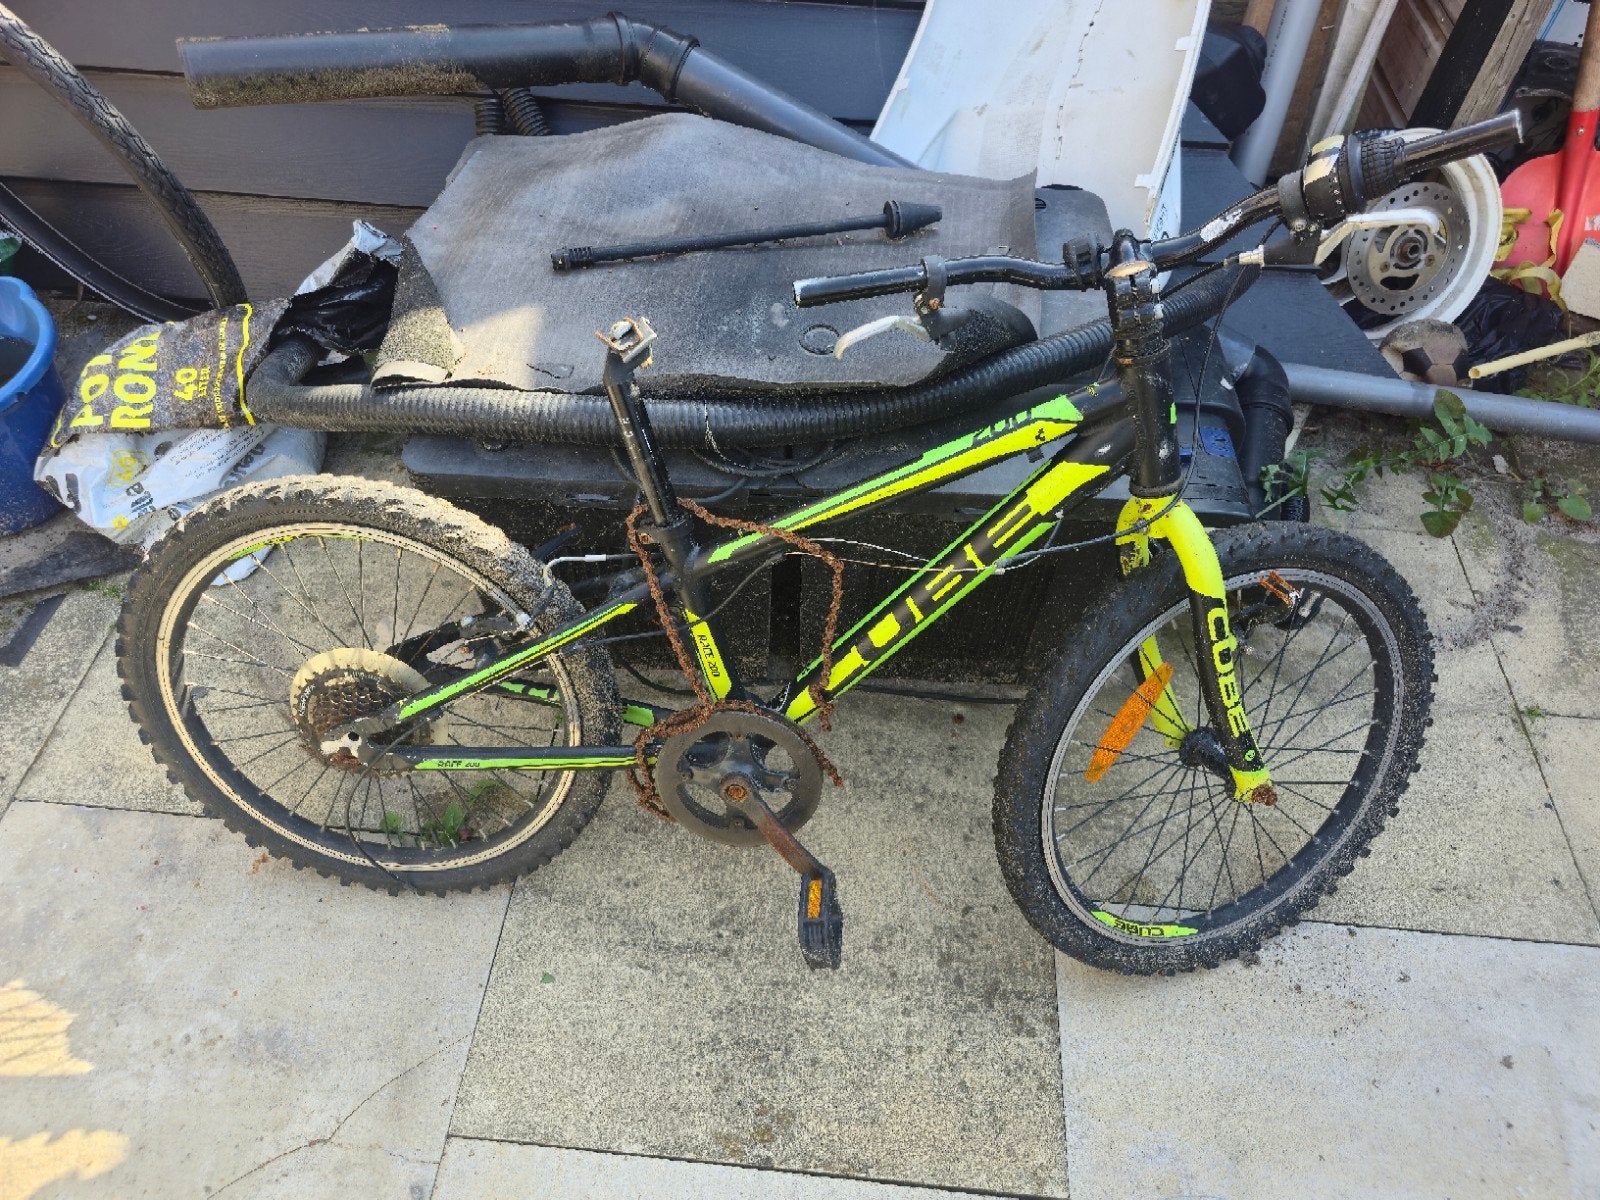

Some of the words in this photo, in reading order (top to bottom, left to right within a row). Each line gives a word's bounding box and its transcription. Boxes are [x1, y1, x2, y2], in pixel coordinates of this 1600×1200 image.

[174, 367, 198, 400] 40
[697, 635, 714, 659] RACE
[708, 661, 720, 677] 200
[1207, 607, 1252, 738] CUBE
[1114, 919, 1165, 936] CUBE
